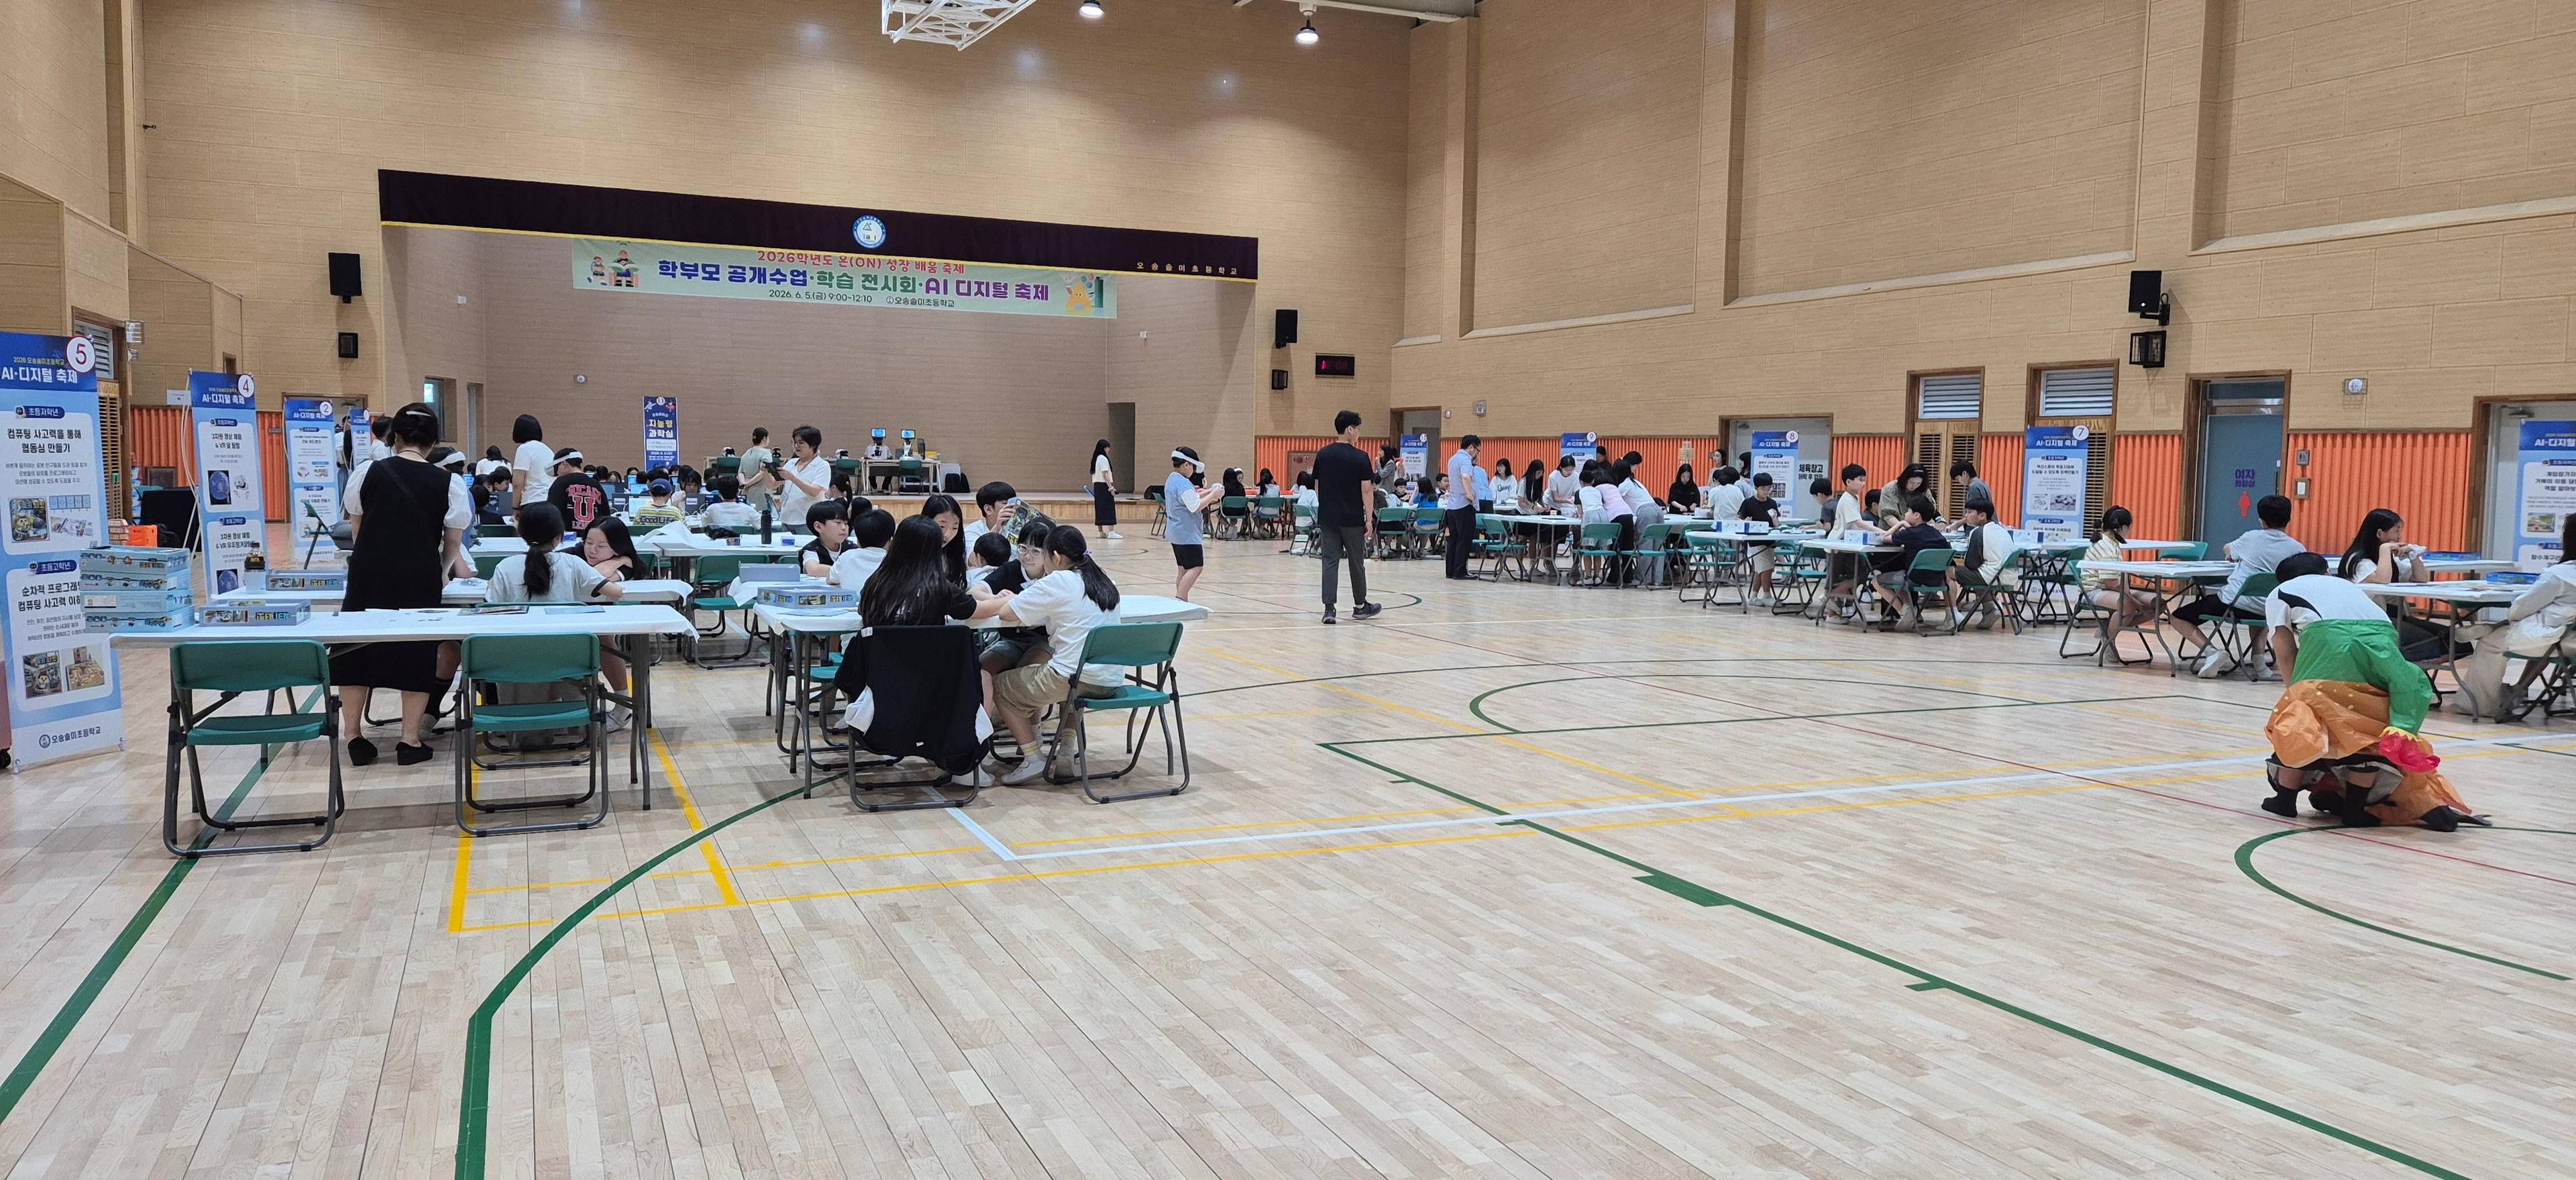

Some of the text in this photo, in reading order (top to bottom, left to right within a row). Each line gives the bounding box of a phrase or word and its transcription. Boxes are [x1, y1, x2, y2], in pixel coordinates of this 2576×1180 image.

[757, 250, 964, 274] 2026학년도 온(ON) 성장 배움 축제
[658, 260, 720, 282] 학부모
[955, 280, 1009, 299] 디지털
[1014, 283, 1049, 301] 축제
[894, 297, 955, 308] 오송솔미초등학교
[75, 343, 87, 365] 5
[1, 366, 78, 384] AI·디지털 축제
[243, 379, 250, 392] 4
[323, 404, 329, 413] 2
[648, 419, 673, 428] 지능형
[7, 428, 82, 439] 컴퓨팅 사고력을 통해
[648, 429, 674, 438] 과학실
[1789, 432, 1795, 440] 8
[2078, 427, 2084, 437] 7
[21, 443, 70, 453] 협동심 만들기
[1799, 464, 1823, 473] 체육창고
[2235, 469, 2255, 480] 여자
[572, 496, 596, 523] U
[42, 563, 71, 572] 초등고학년
[22, 584, 45, 597] 순차적
[18, 599, 42, 612] 컴퓨팅
[44, 596, 66, 608] 사고력
[52, 726, 101, 744] 오송솔미초등학교
